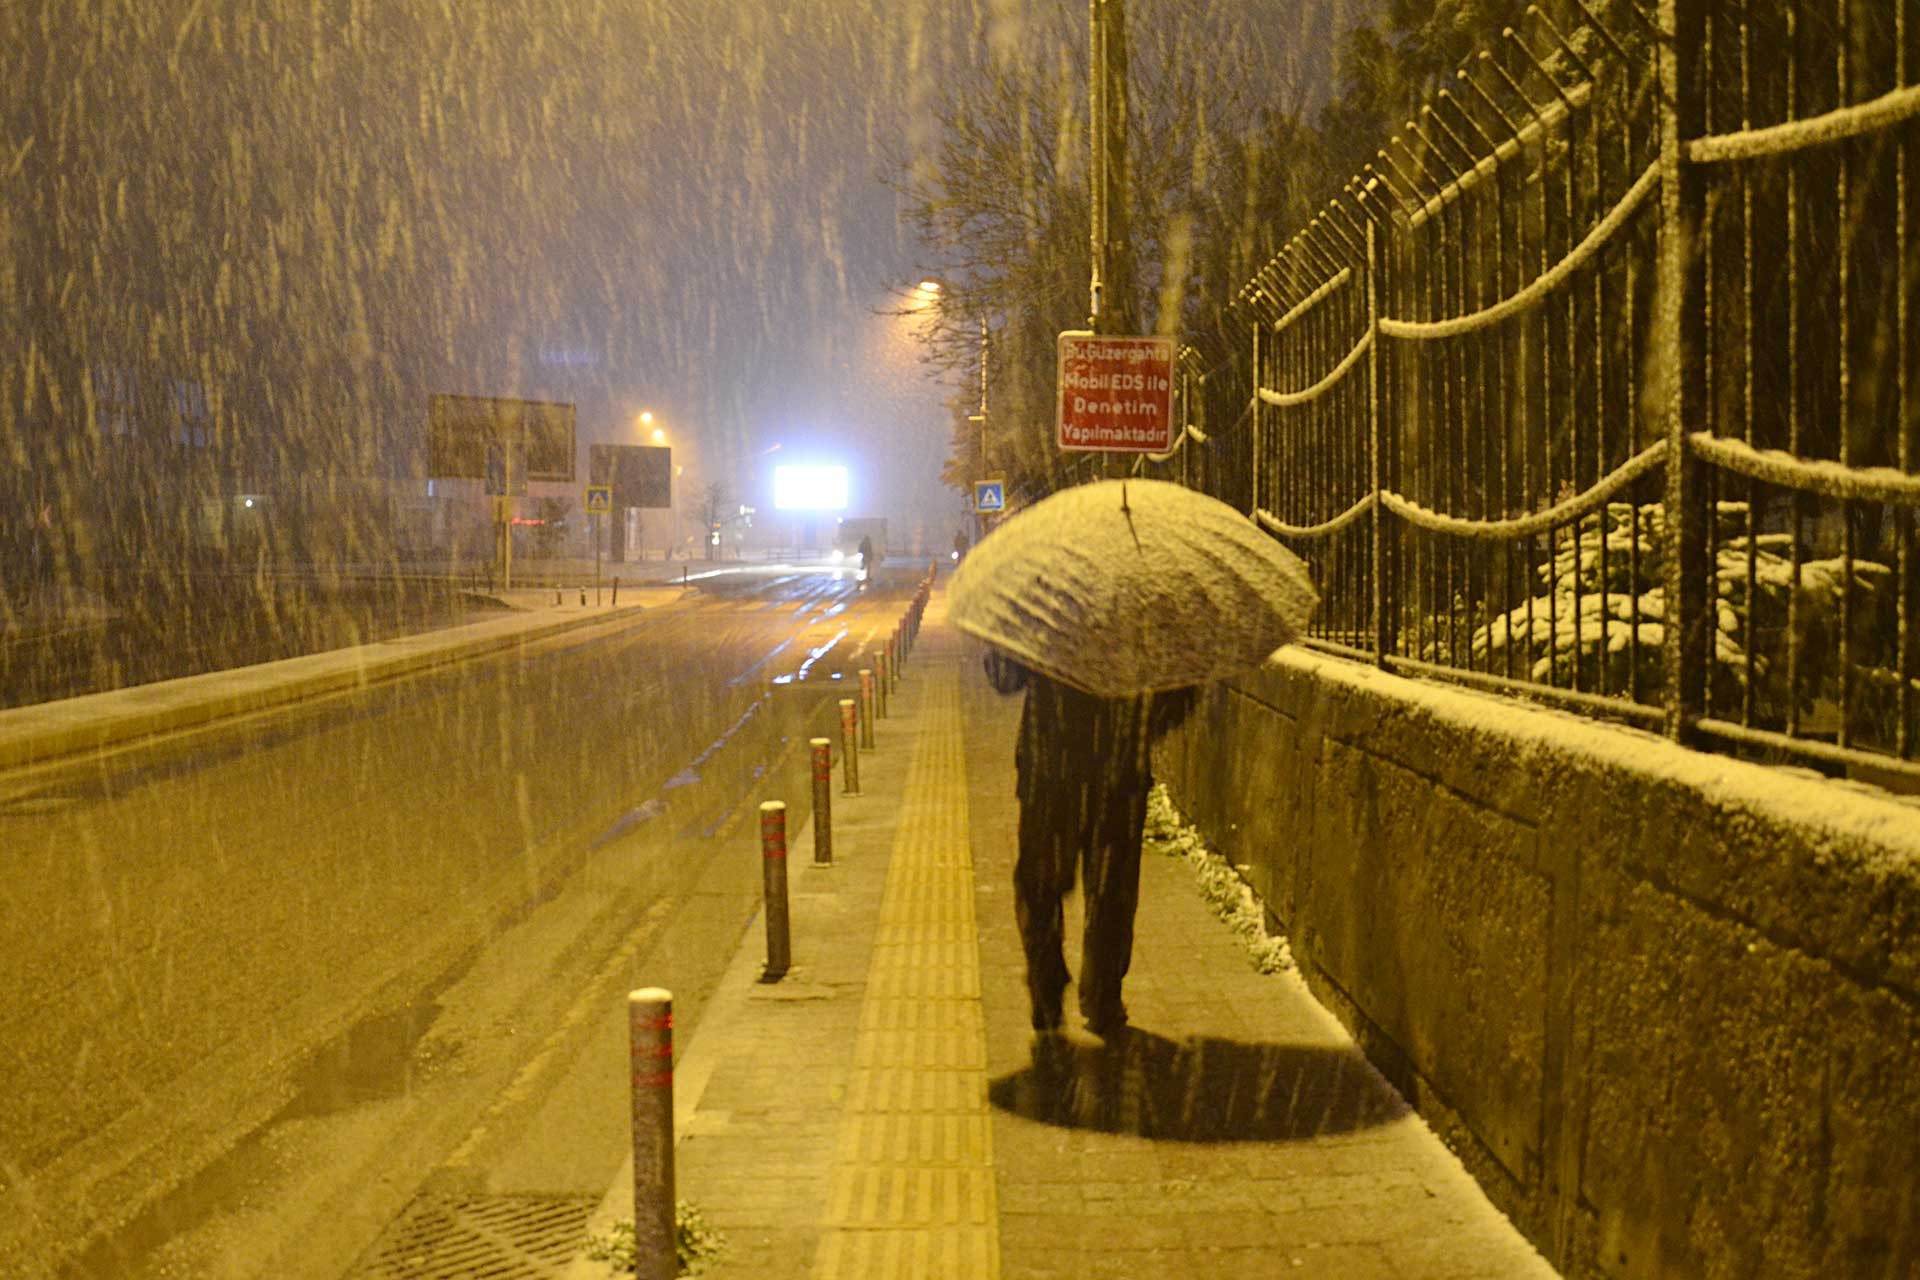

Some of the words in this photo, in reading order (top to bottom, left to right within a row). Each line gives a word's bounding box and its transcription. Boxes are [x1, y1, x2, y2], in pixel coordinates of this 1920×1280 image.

[1065, 371, 1109, 390] Mobil
[1111, 373, 1145, 391] EDS
[1147, 374, 1169, 391] ile
[1073, 396, 1158, 415] Denetim
[1062, 423, 1168, 444] Yapılmaktadır
